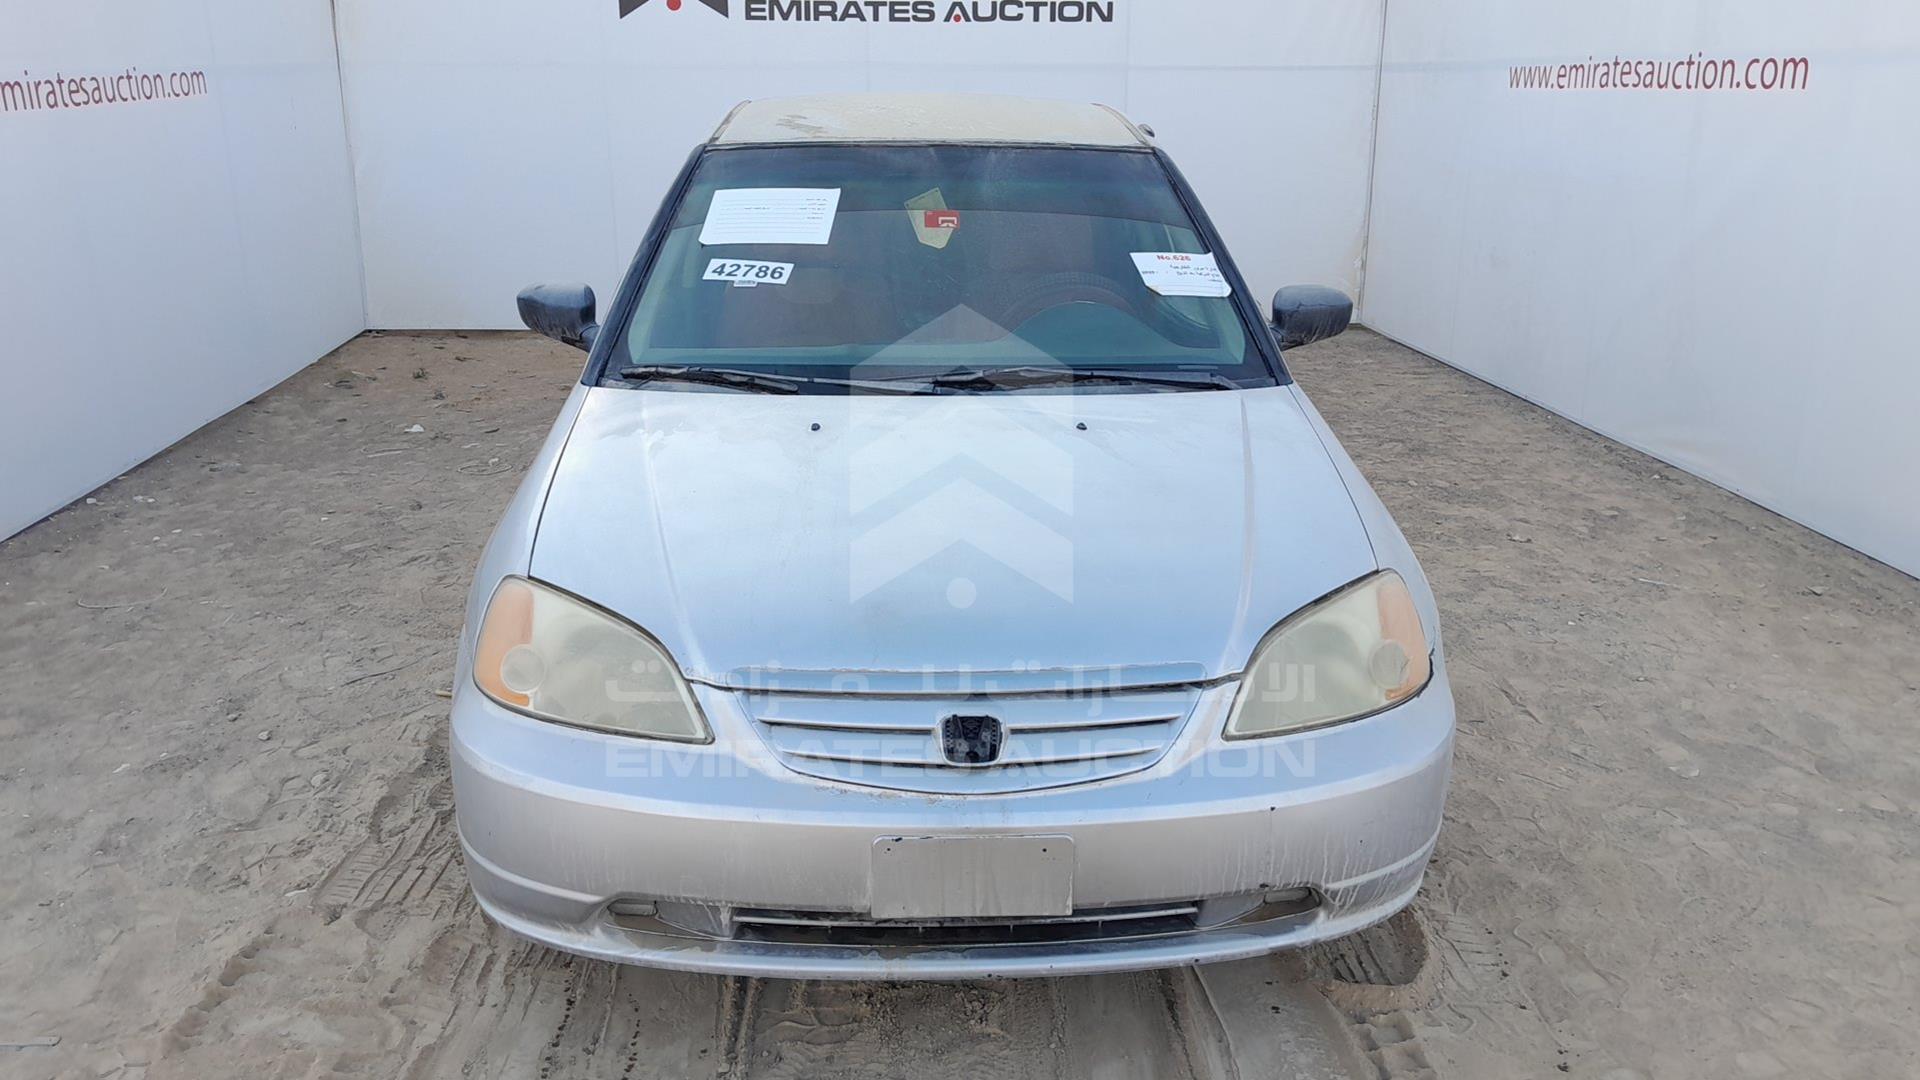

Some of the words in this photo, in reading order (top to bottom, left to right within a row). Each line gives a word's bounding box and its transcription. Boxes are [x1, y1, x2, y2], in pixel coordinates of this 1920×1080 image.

[744, 0, 936, 22] EMIRATES
[943, 1, 1114, 22] AUCTION
[1509, 51, 1809, 90] www.emiratesauction.com
[711, 262, 785, 280] 42786
